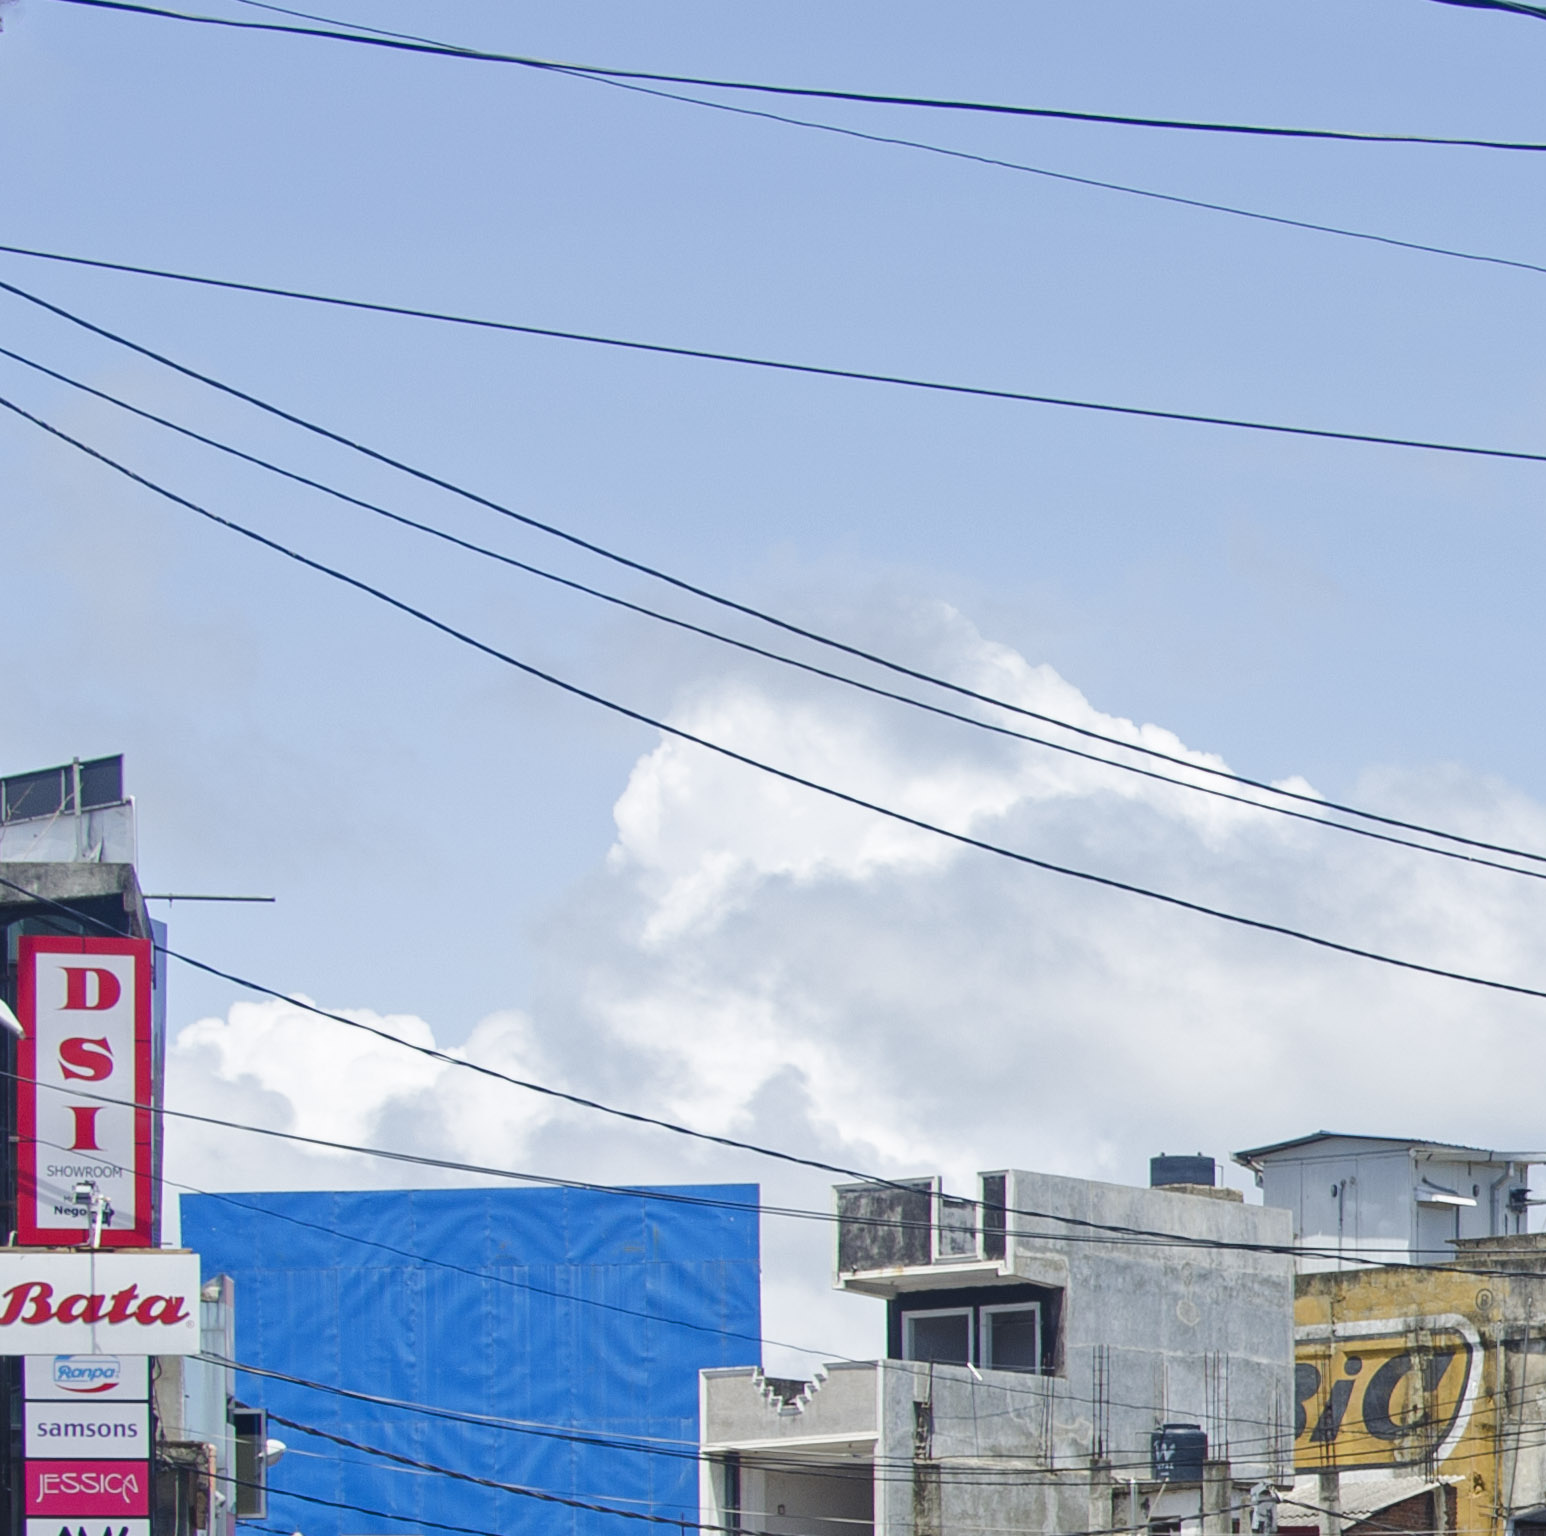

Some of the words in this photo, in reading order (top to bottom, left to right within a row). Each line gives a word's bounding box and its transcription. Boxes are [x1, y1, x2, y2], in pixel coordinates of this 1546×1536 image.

[57, 966, 121, 1151] DSI
[47, 1165, 123, 1178] SHOWROOM
[0, 1282, 190, 1326] Bata
[58, 1365, 115, 1381] Ranpa
[37, 1422, 138, 1438] samsons
[36, 1472, 139, 1504] JESSICA
